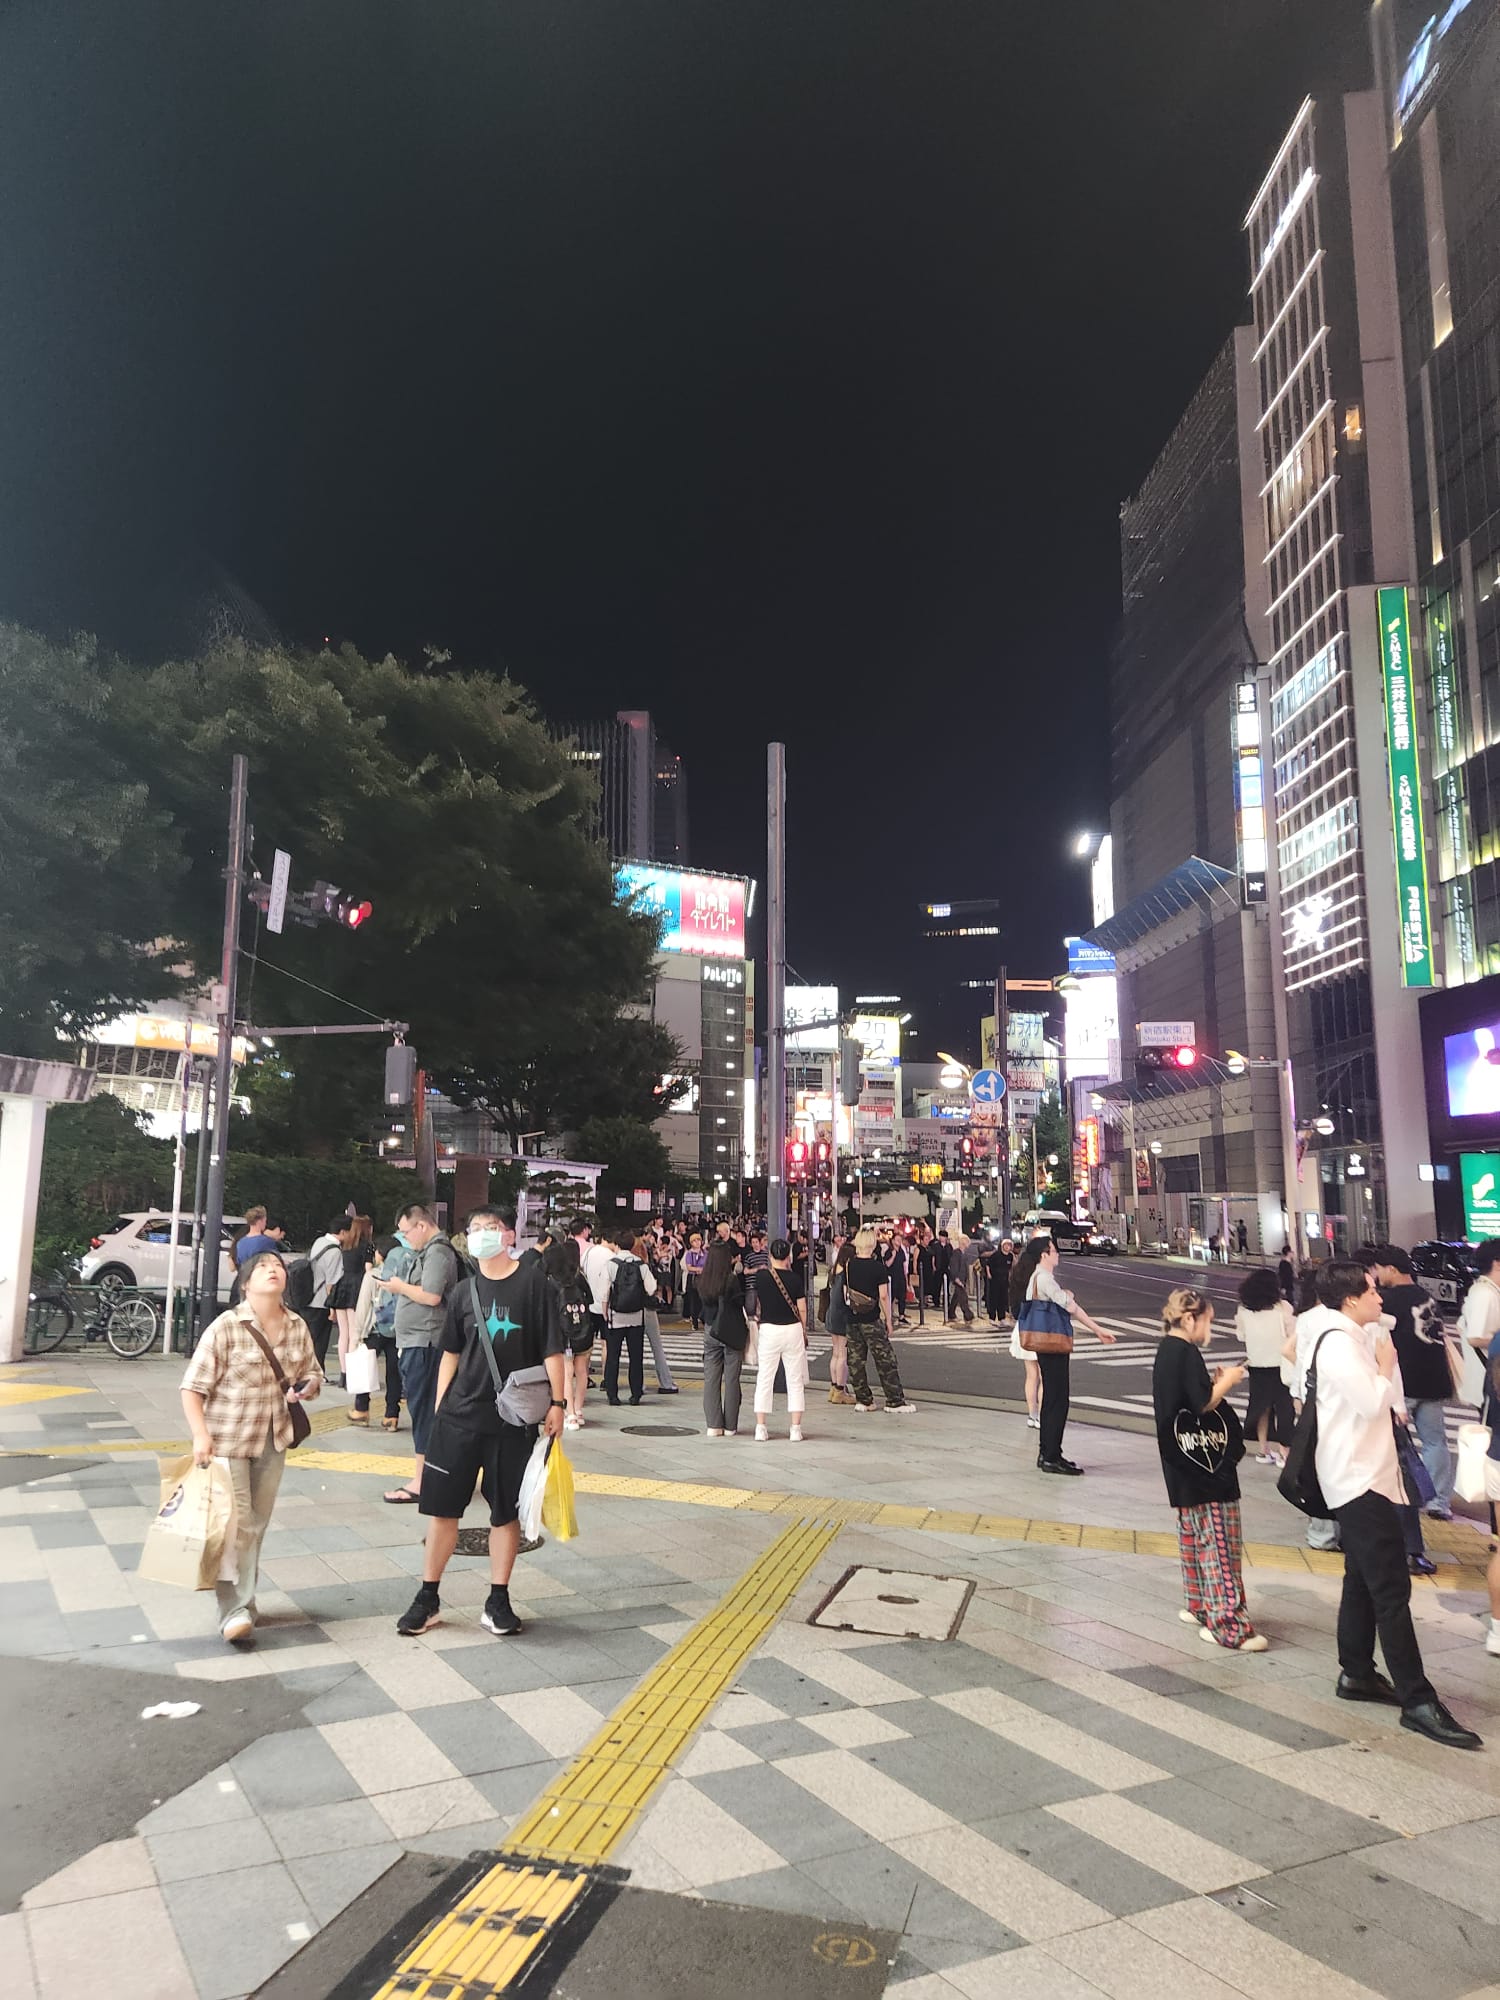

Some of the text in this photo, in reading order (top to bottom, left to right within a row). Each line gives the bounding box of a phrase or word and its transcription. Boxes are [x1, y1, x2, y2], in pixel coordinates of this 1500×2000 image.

[1390, 632, 1402, 671] SMBC
[1008, 1015, 1042, 1037] カラオケ
[1144, 1024, 1192, 1035] 新宿駅東口
